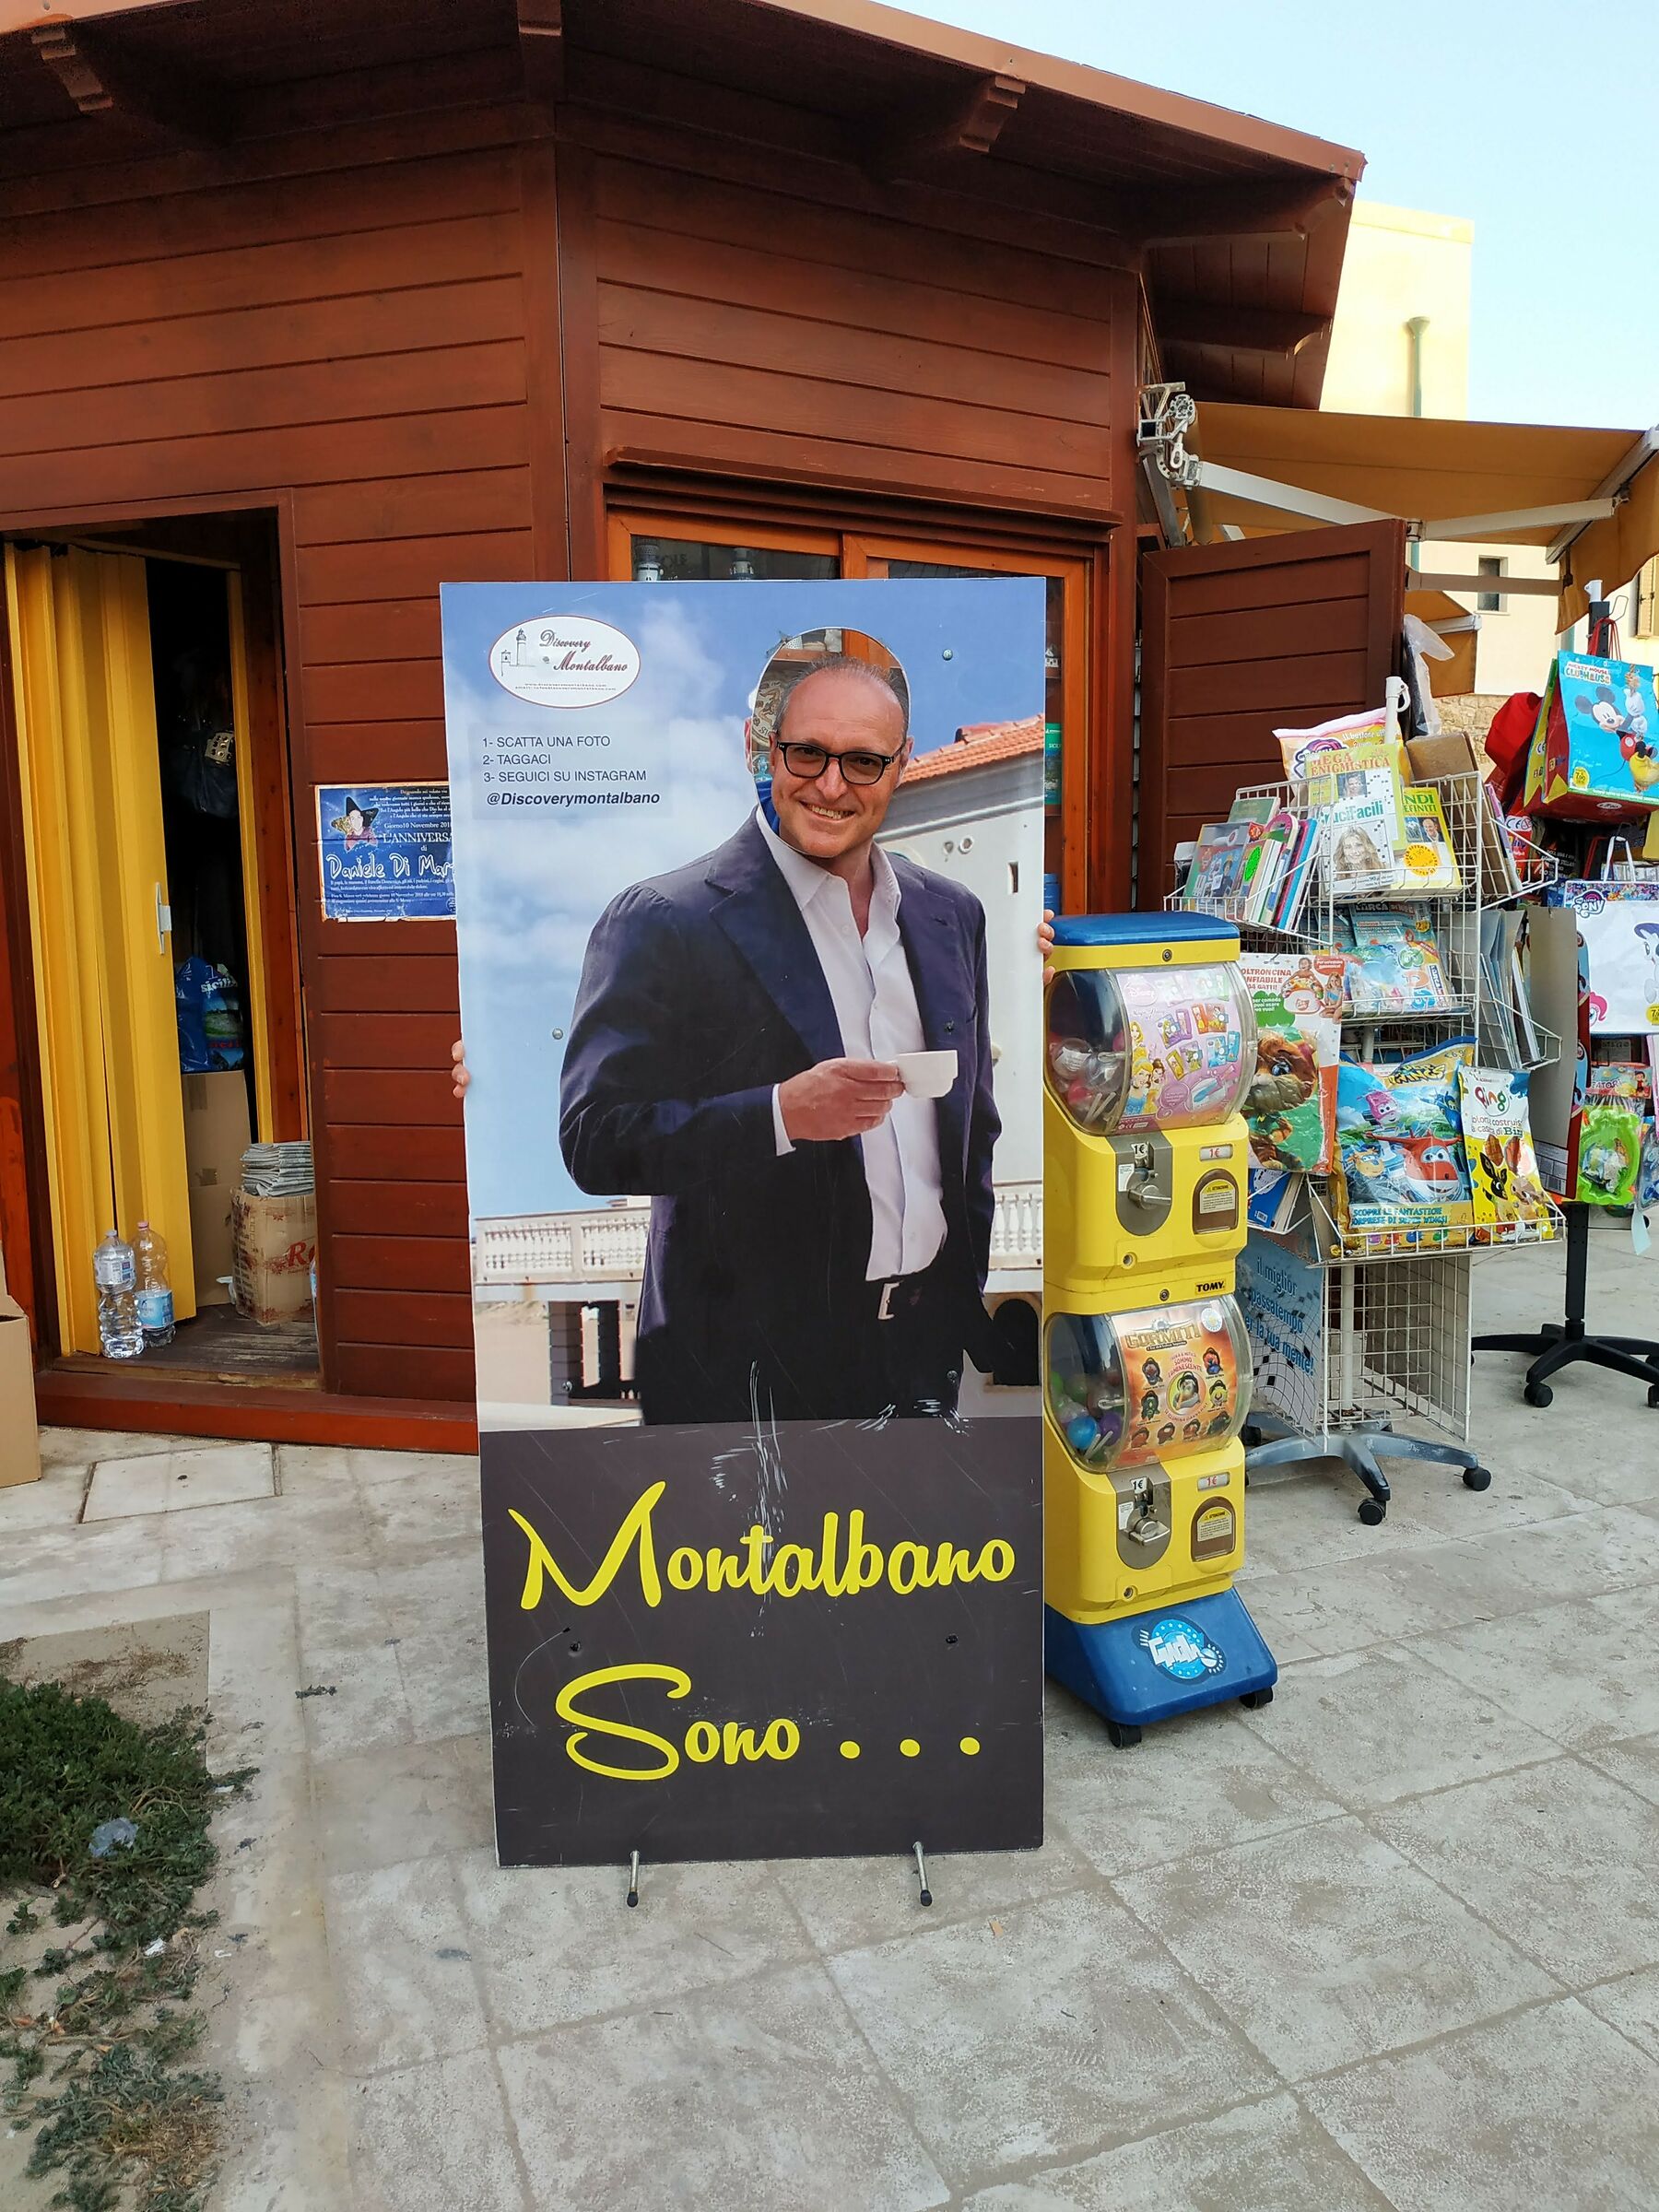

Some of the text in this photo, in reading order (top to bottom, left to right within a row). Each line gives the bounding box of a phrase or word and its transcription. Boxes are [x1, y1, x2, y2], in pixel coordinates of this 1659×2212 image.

[539, 629, 591, 653] Discovery
[553, 651, 628, 672] Montalbano
[482, 735, 610, 747] 1- SCATTA UNA FOTO
[482, 754, 551, 765] 2- TAGGACI
[1311, 758, 1391, 777] ENIGMISTICA
[483, 771, 647, 782] 3- SEGUICI SU INSTAGRAM
[487, 792, 661, 807] @Discoverymontalbano
[410, 818, 439, 829] Novembre
[325, 853, 385, 879] Daniele
[389, 853, 410, 877] Di
[1241, 968, 1291, 976] OLTRONCINA
[1134, 1144, 1145, 1155] 1€
[1208, 1148, 1220, 1159] 1€
[1353, 1208, 1382, 1217] SCOPRI
[1196, 1281, 1225, 1293] TOMY
[1265, 1265, 1298, 1298] miglior
[1251, 1288, 1304, 1335] passatempo
[1244, 1312, 1254, 1334] er
[1256, 1318, 1265, 1339] la
[1266, 1328, 1281, 1352] tua
[1133, 1479, 1144, 1490] 1€
[1206, 1476, 1218, 1487] 1€
[508, 1480, 1016, 1610] Montalbano
[556, 1663, 801, 1781] Sono
